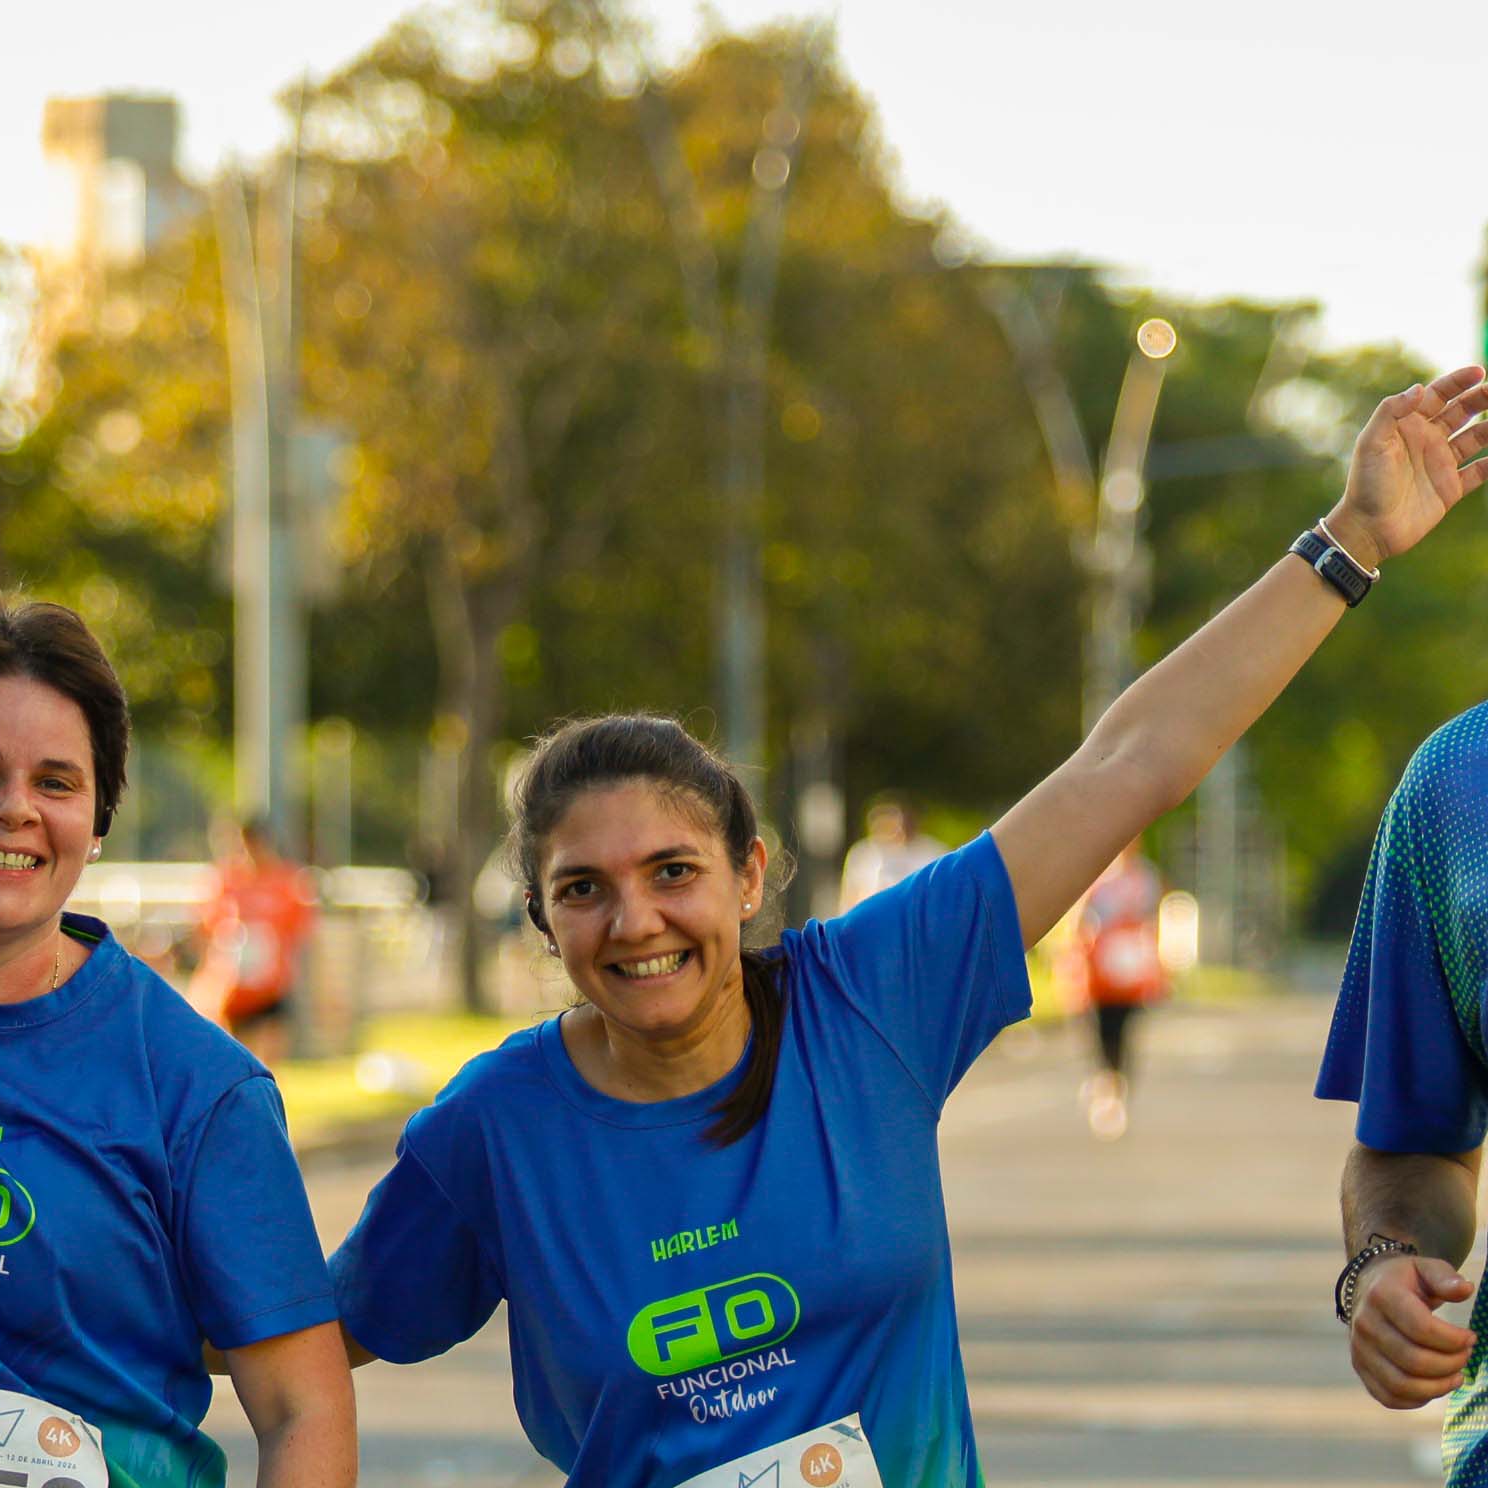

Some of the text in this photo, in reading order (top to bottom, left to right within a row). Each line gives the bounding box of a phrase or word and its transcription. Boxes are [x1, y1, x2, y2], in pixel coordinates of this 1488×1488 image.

[651, 1217, 740, 1263] HARLEM
[656, 1347, 797, 1401] FUNCIONAL
[689, 1383, 778, 1424] Outdoor
[45, 1427, 73, 1448] 4K
[809, 1455, 836, 1478] 4K
